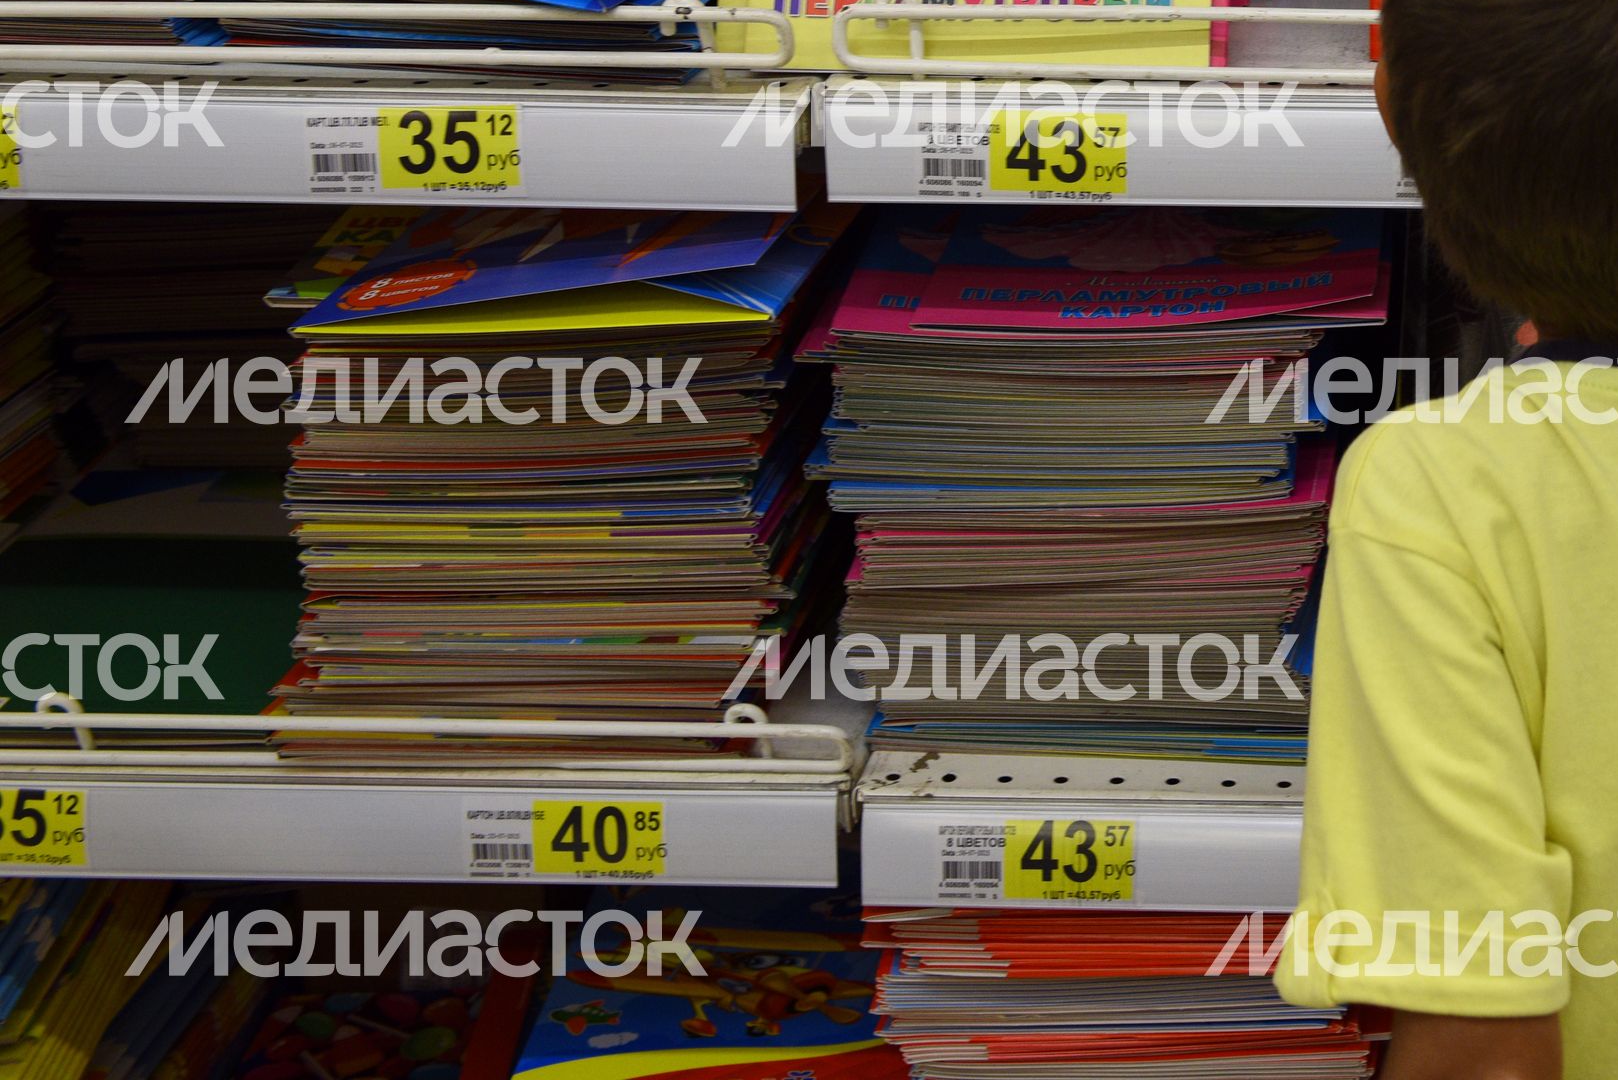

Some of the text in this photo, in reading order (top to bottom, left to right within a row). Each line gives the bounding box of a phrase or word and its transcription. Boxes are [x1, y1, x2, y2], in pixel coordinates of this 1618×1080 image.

[486, 114, 513, 136] 12
[399, 111, 480, 175] 35
[937, 134, 990, 146] ЦВЕТОВ
[1093, 126, 1120, 147] 57
[487, 150, 521, 170] руб
[1006, 119, 1087, 182] 43
[1094, 162, 1127, 181] руб
[371, 277, 394, 289] 8
[959, 271, 1334, 304] ПЕРЛАМУТРОВЫЙ
[357, 289, 380, 301] 8
[1058, 300, 1225, 319] КАРТОН
[53, 795, 79, 815] 12
[0, 789, 46, 847] 5
[634, 811, 660, 832] 85
[53, 828, 86, 846] руб
[552, 805, 628, 863] 40
[946, 837, 1007, 848] 8 ЦВЕТОВ
[1104, 826, 1130, 846] 57
[635, 844, 668, 861] руб
[1020, 820, 1098, 882] 43
[1104, 860, 1136, 879] руб
